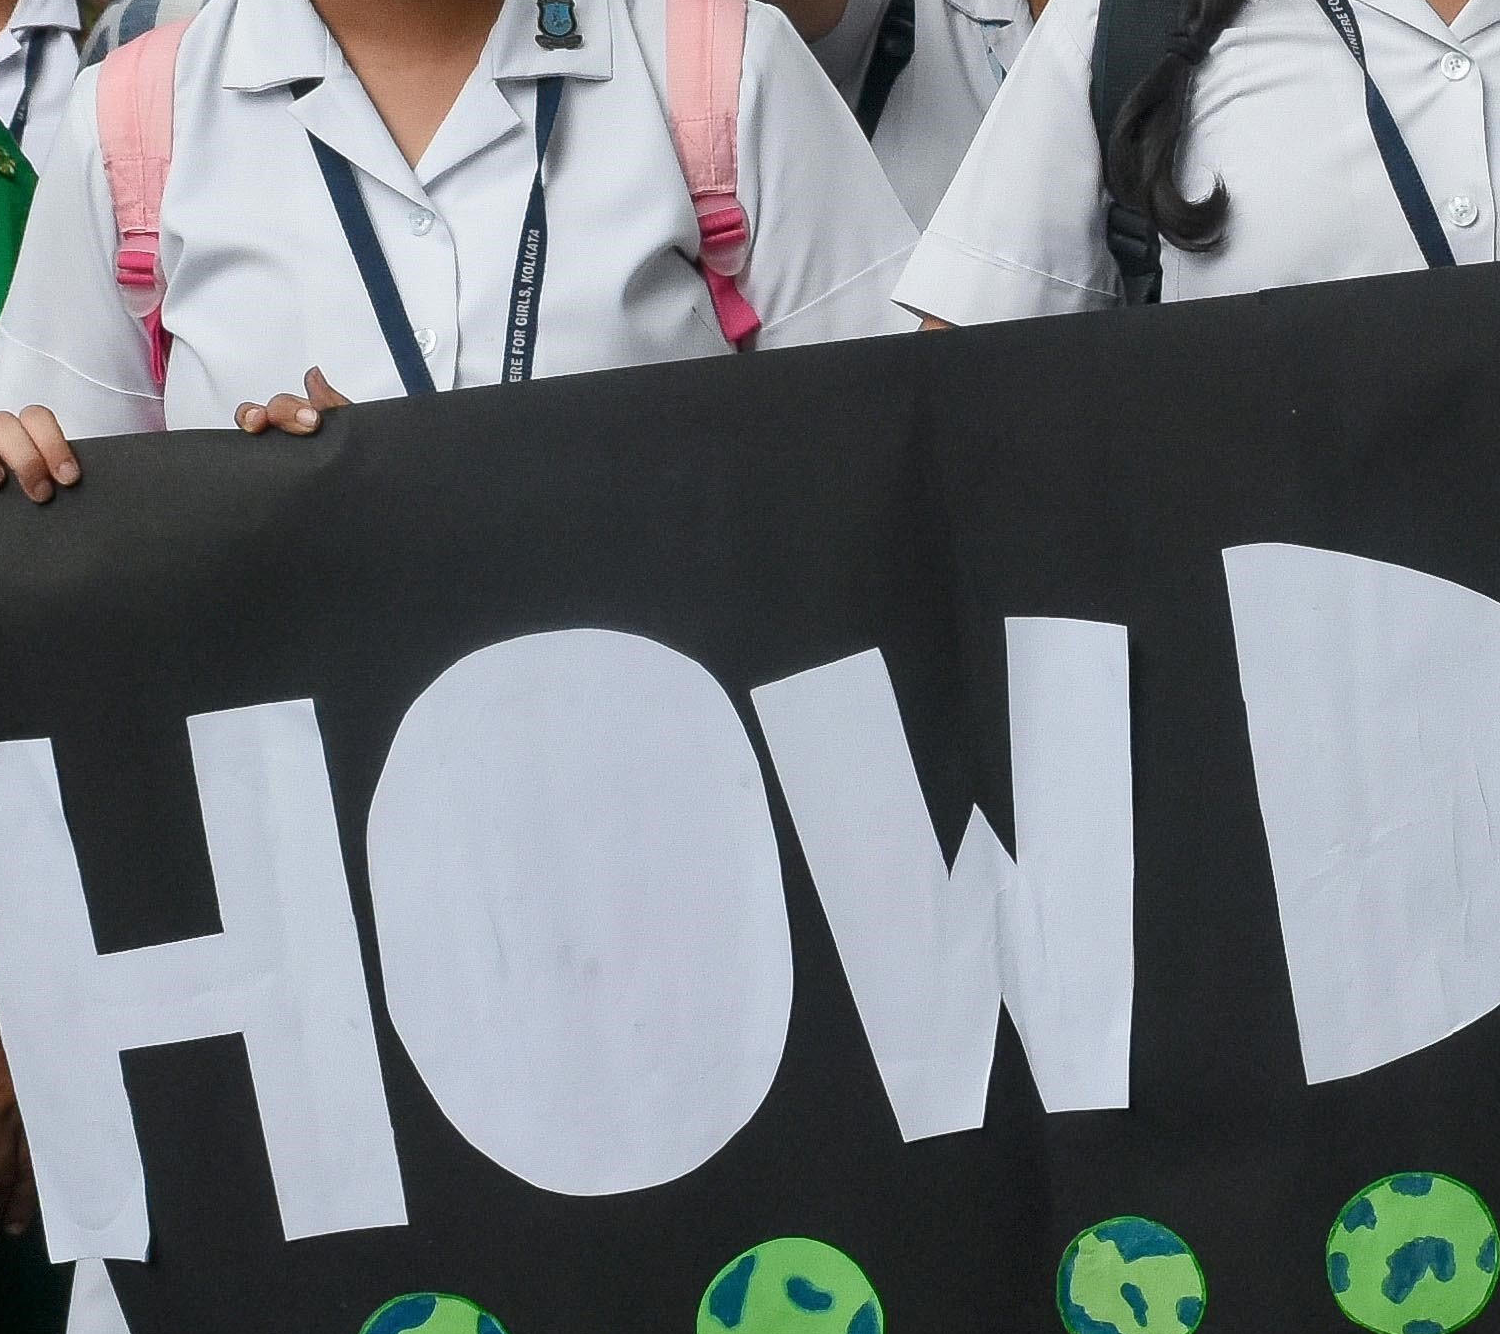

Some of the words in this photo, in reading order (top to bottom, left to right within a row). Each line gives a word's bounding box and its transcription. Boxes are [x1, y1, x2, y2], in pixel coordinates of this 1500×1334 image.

[520, 229, 541, 284] KOLKATA
[513, 288, 536, 328] GIRLS,
[511, 328, 526, 356] FOR
